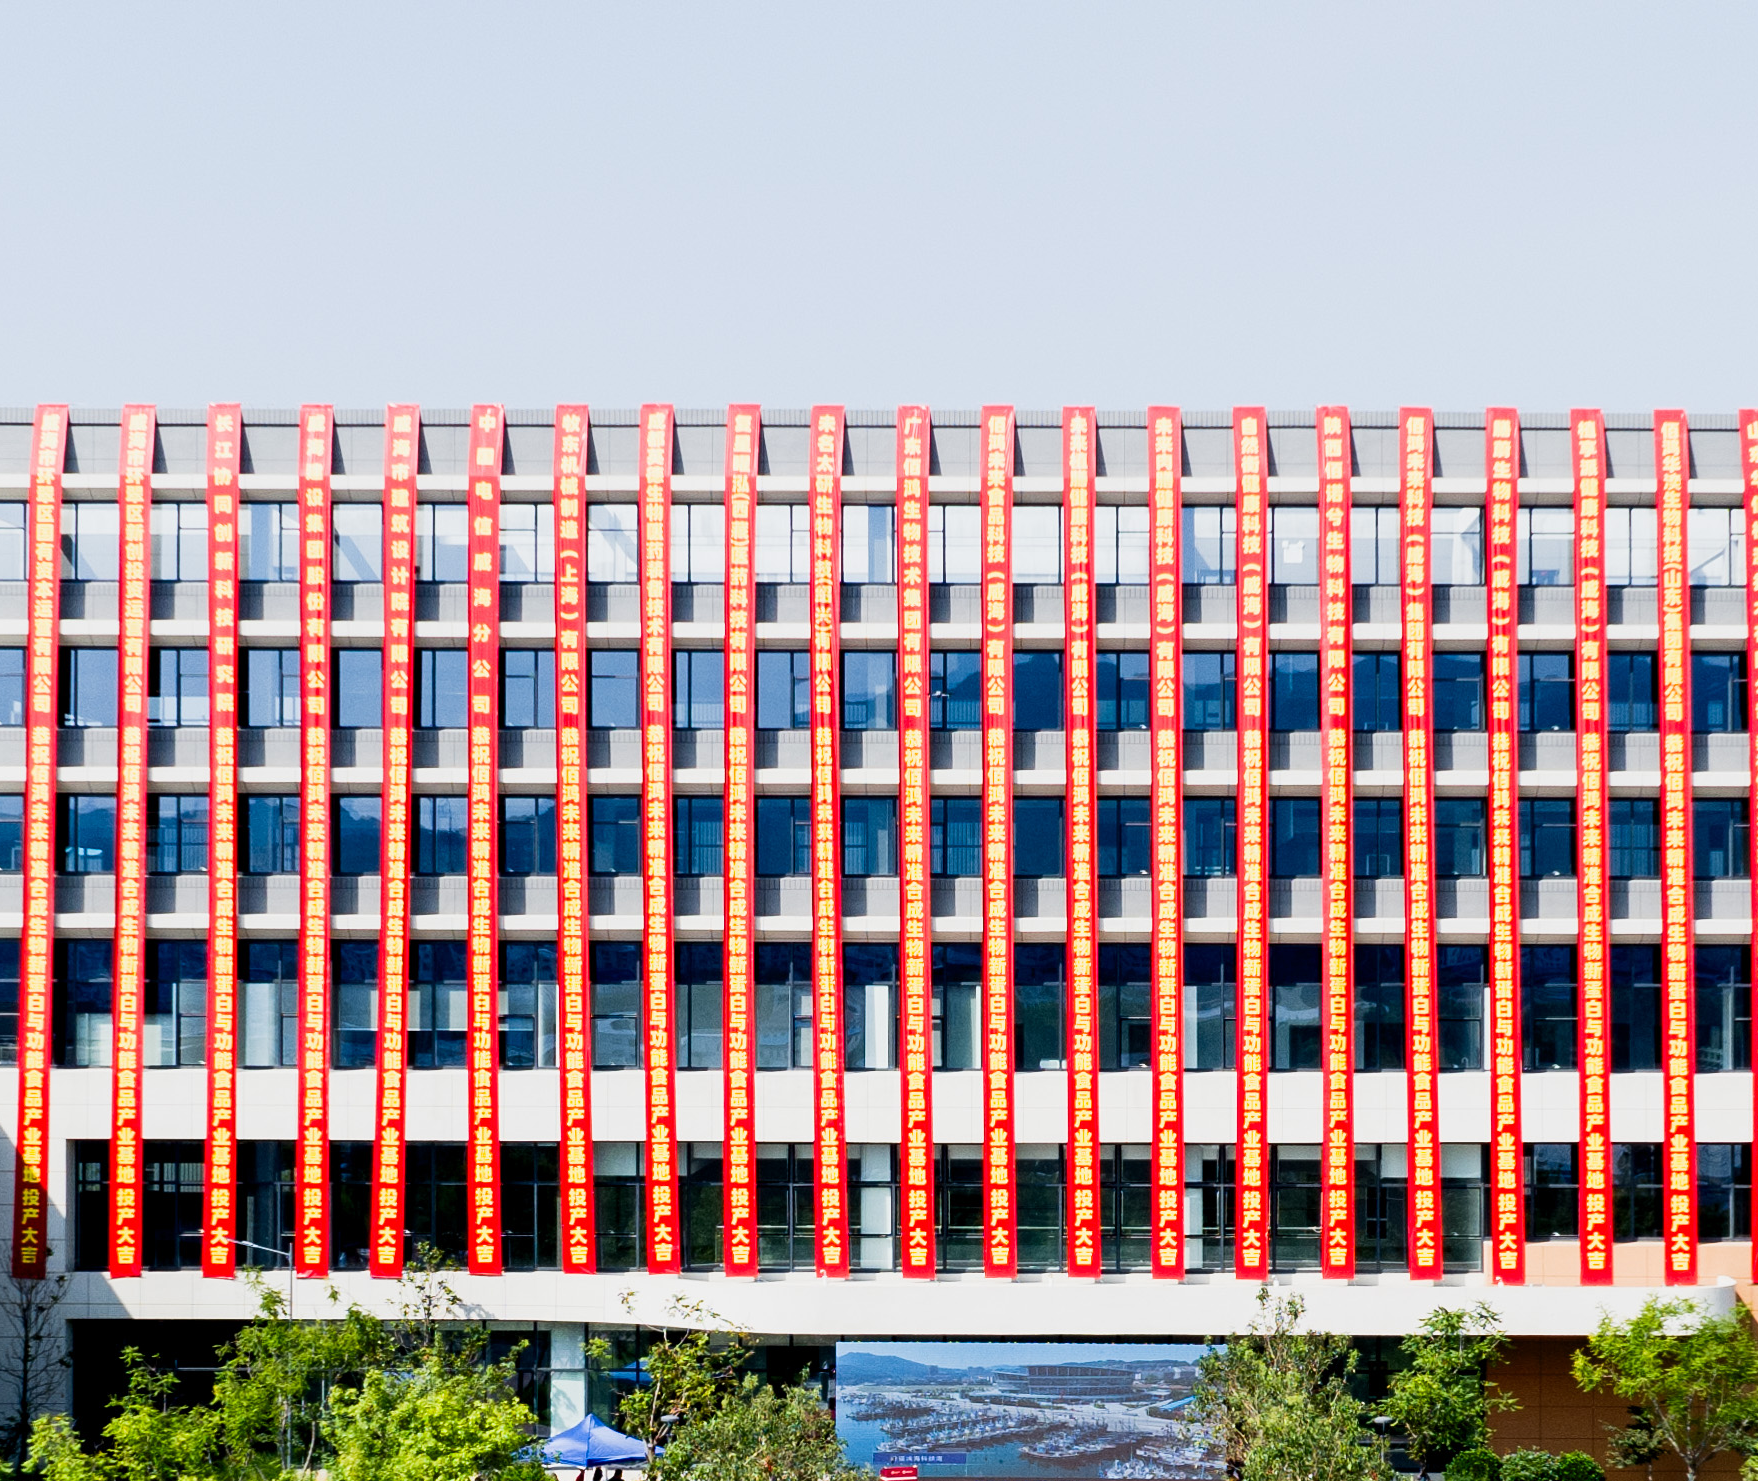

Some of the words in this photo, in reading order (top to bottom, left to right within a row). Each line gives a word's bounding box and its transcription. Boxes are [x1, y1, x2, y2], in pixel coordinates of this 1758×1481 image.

[213, 414, 235, 712] 长江协同创新科技研究院
[472, 415, 496, 714] 中国电信威海分公司
[21, 1188, 40, 1264] 投产大吉
[116, 1188, 135, 1264] 投产大吉
[210, 1188, 230, 1264] 投产大吉
[303, 1188, 322, 1264] 投产大吉
[377, 1188, 398, 1264] 投产大吉
[475, 1187, 494, 1263] 投产大吉
[568, 1188, 588, 1264] 投产大吉
[652, 1185, 672, 1261] 投产大吉
[730, 1187, 750, 1264] 投产大吉
[821, 1188, 841, 1264] 投产大吉
[908, 1189, 928, 1266] 投产大吉
[990, 1188, 1010, 1265] 投产大吉
[1074, 1189, 1093, 1265] 投产大吉
[1159, 1190, 1178, 1266] 投产大吉
[1242, 1190, 1261, 1266] 投产大吉
[1329, 1189, 1348, 1266] 投产大吉
[1415, 1190, 1435, 1266] 投产大吉
[1498, 1193, 1517, 1270] 投产大吉
[1586, 1193, 1606, 1270] 投产大吉
[1670, 1195, 1690, 1271] 投产大吉
